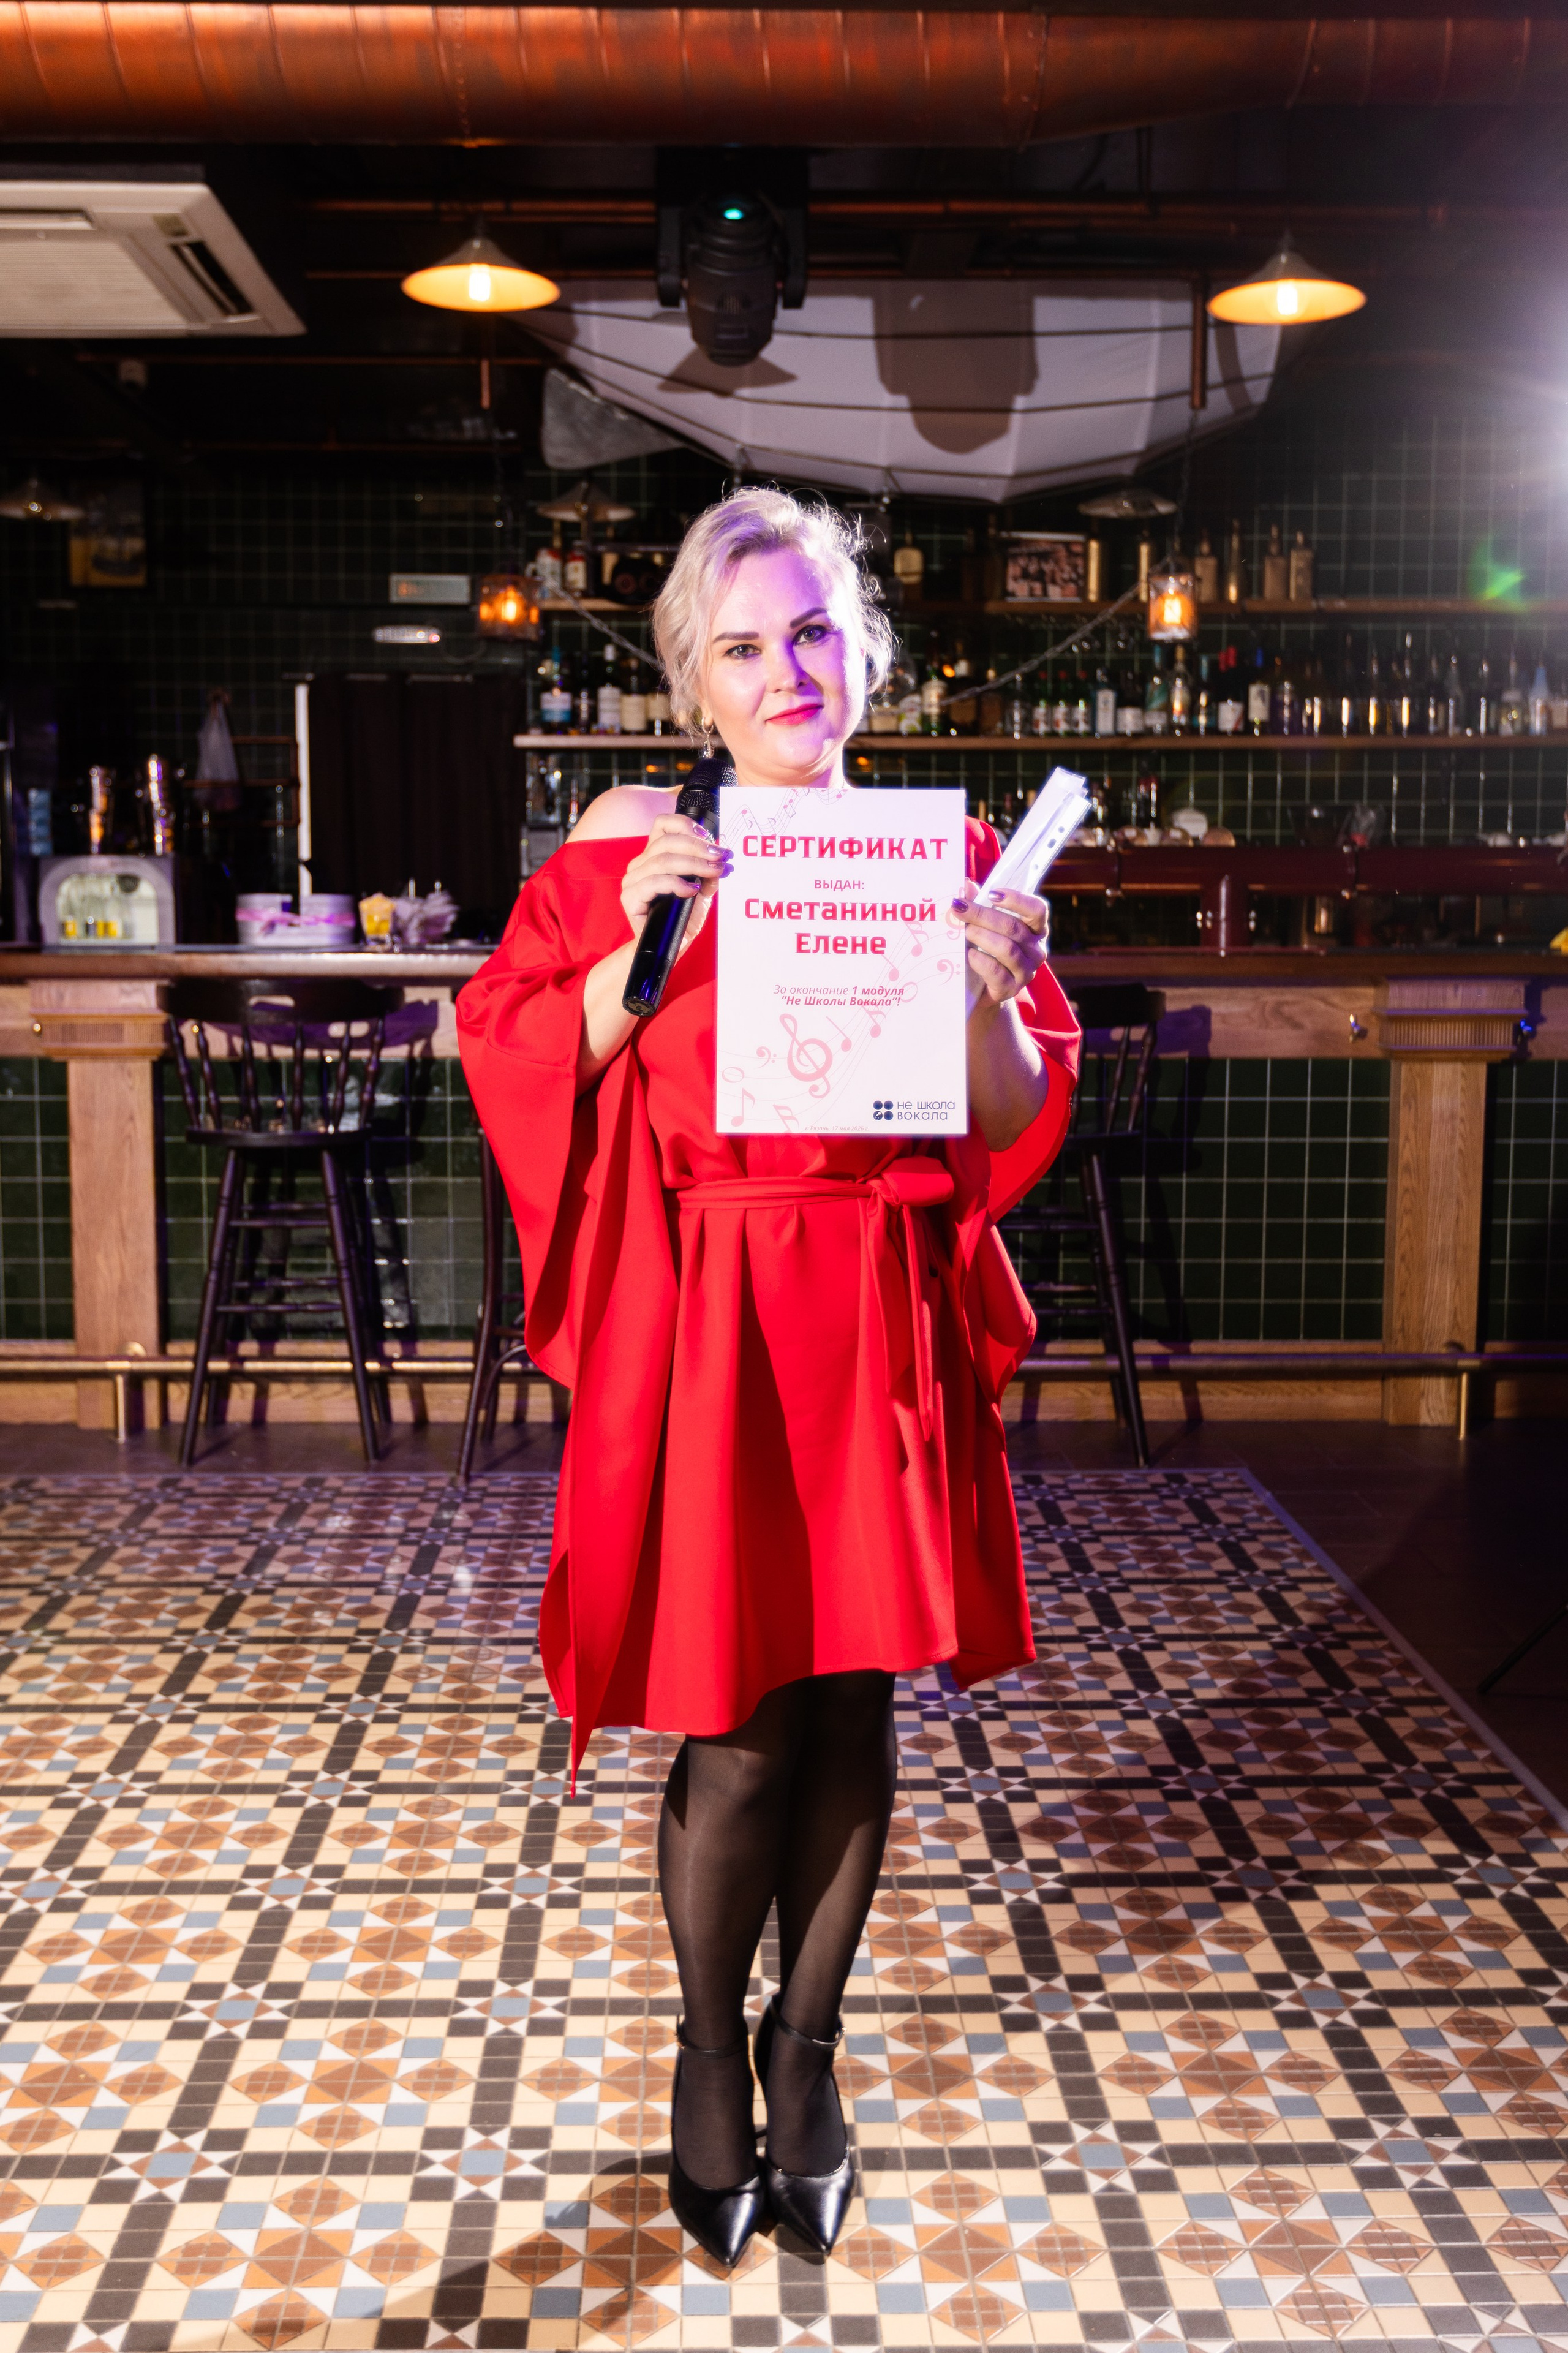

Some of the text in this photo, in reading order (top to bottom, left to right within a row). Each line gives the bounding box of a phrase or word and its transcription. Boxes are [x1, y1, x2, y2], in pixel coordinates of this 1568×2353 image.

[744, 835, 948, 860] СЕРТИФИКАТ
[814, 879, 865, 892] ВЫДАН:
[745, 897, 938, 921] Сметаниной
[794, 932, 886, 954] Елене
[773, 984, 905, 998] За окончание 1 модуля
[782, 995, 901, 1007] "Не Школы Вокала"!
[897, 1101, 956, 1110] не школа
[897, 1111, 948, 1120] вокала
